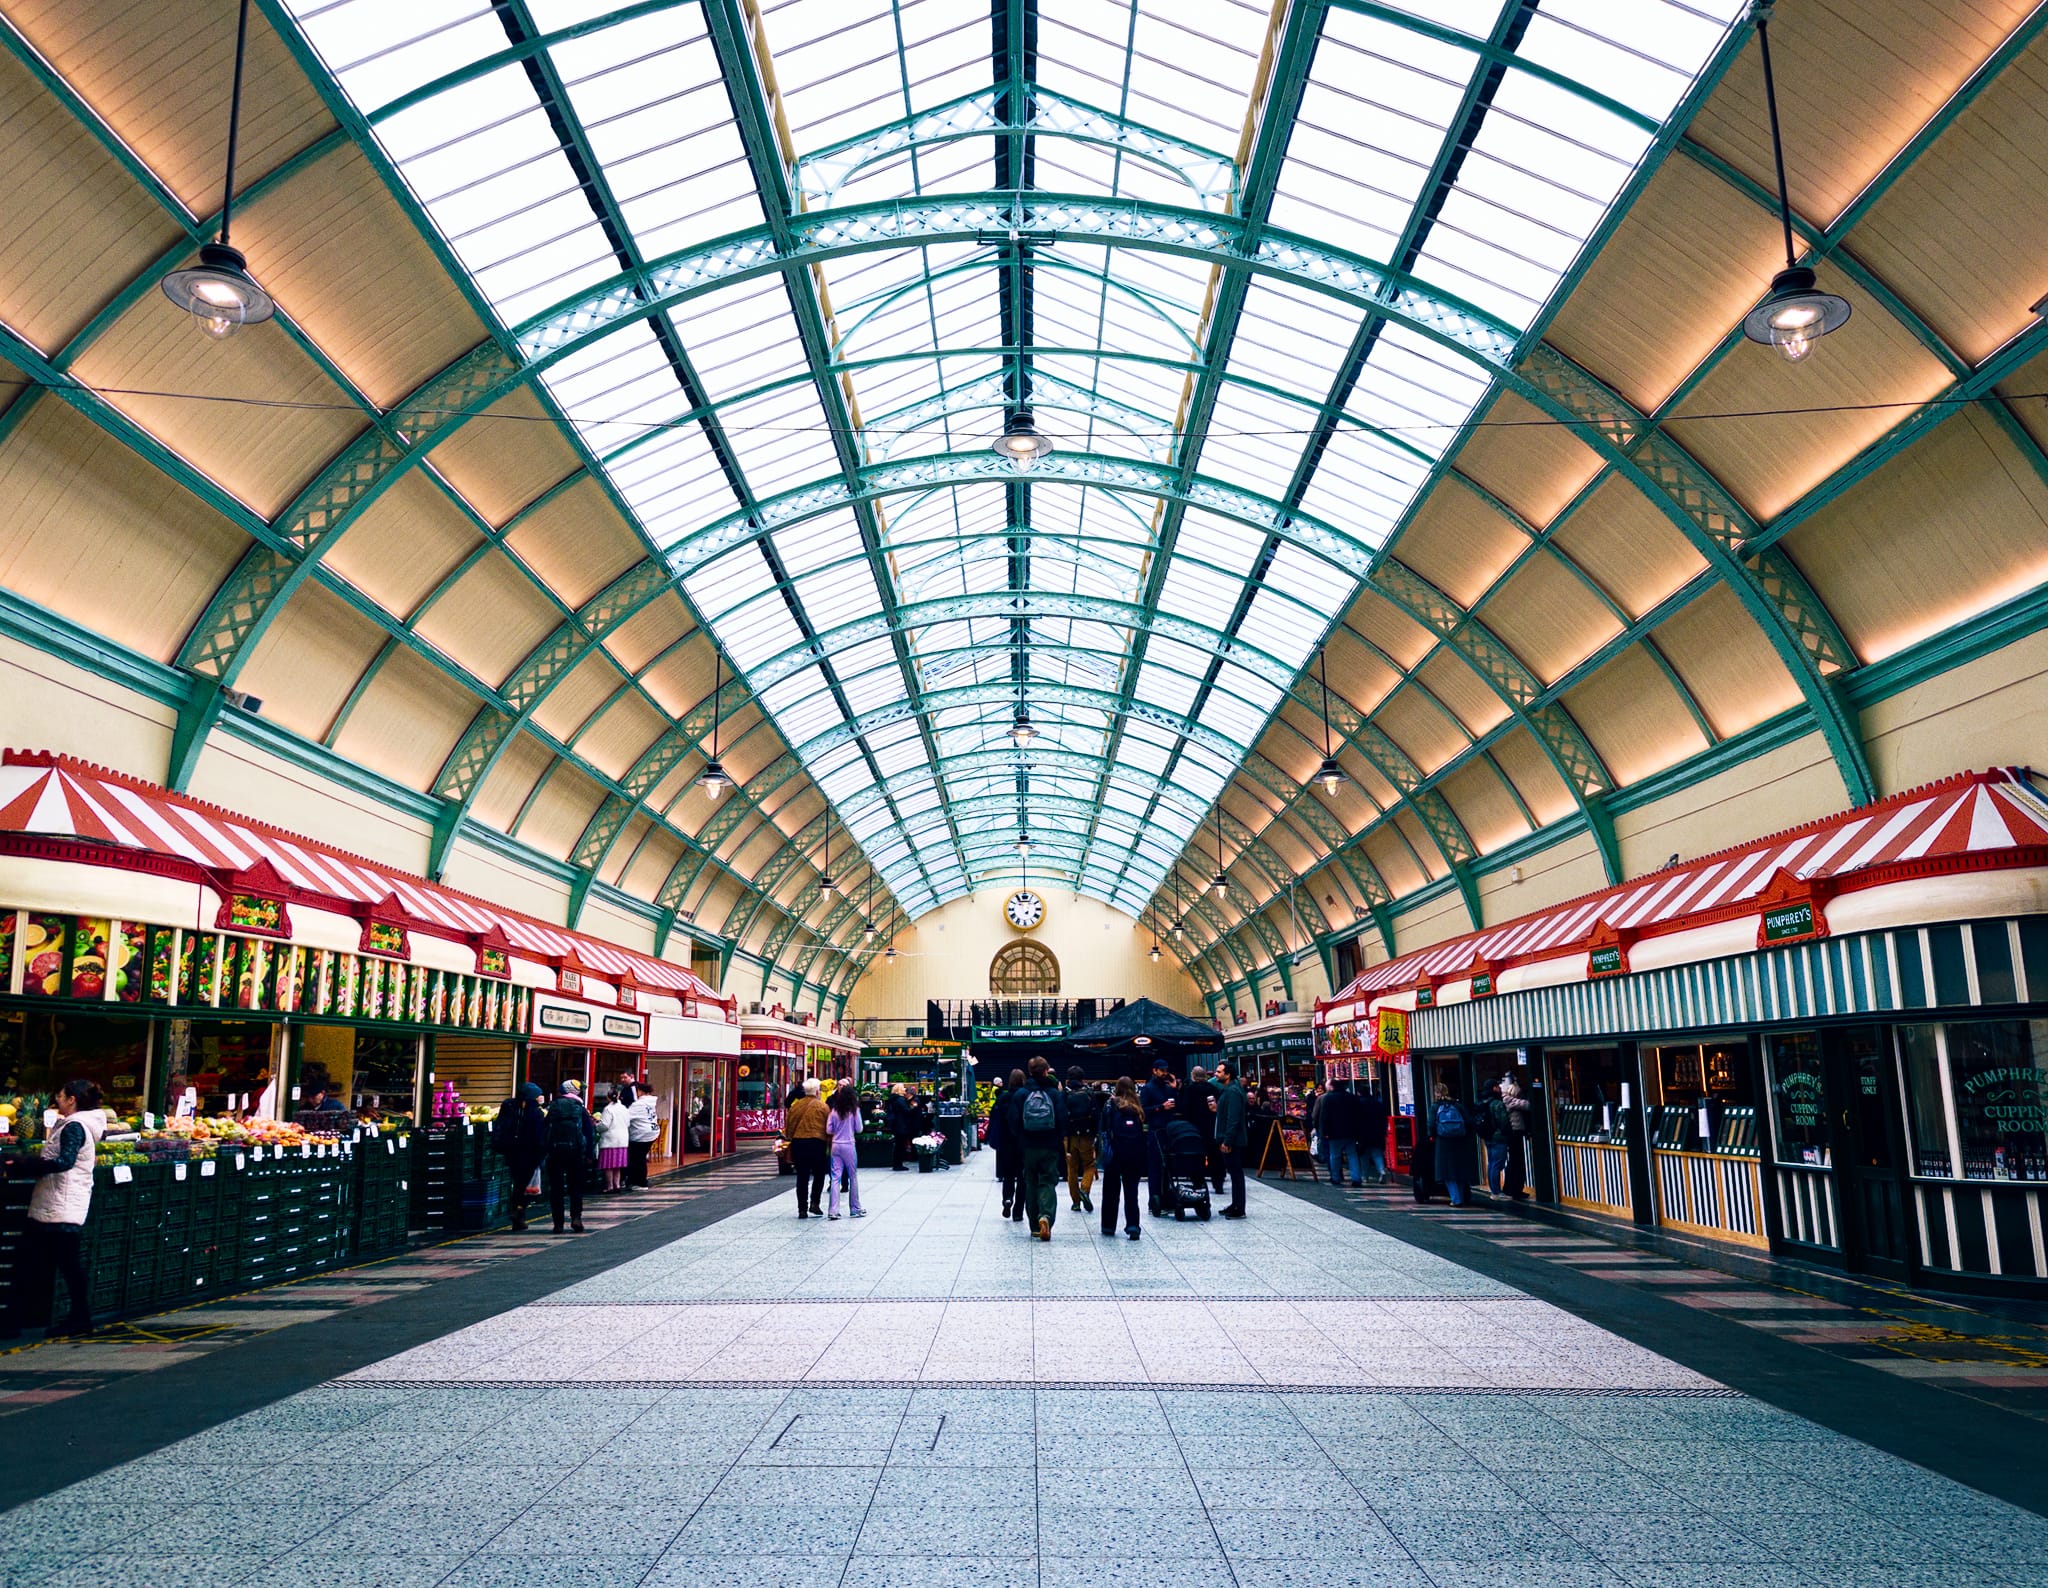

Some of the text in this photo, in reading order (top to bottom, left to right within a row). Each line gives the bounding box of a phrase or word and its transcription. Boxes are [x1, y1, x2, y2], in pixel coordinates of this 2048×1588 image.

[1766, 907, 1812, 929] PUMPHREY'S
[1382, 1025, 1402, 1045] 饭
[879, 1047, 944, 1056] M. J. FAGAN
[1781, 1072, 1822, 1093] PUMPHREY'S
[1860, 1076, 1876, 1085] STAFF
[1862, 1086, 1877, 1095] ONLY
[1790, 1103, 1818, 1114] CUPPING
[1795, 1115, 1816, 1126] ROOM
